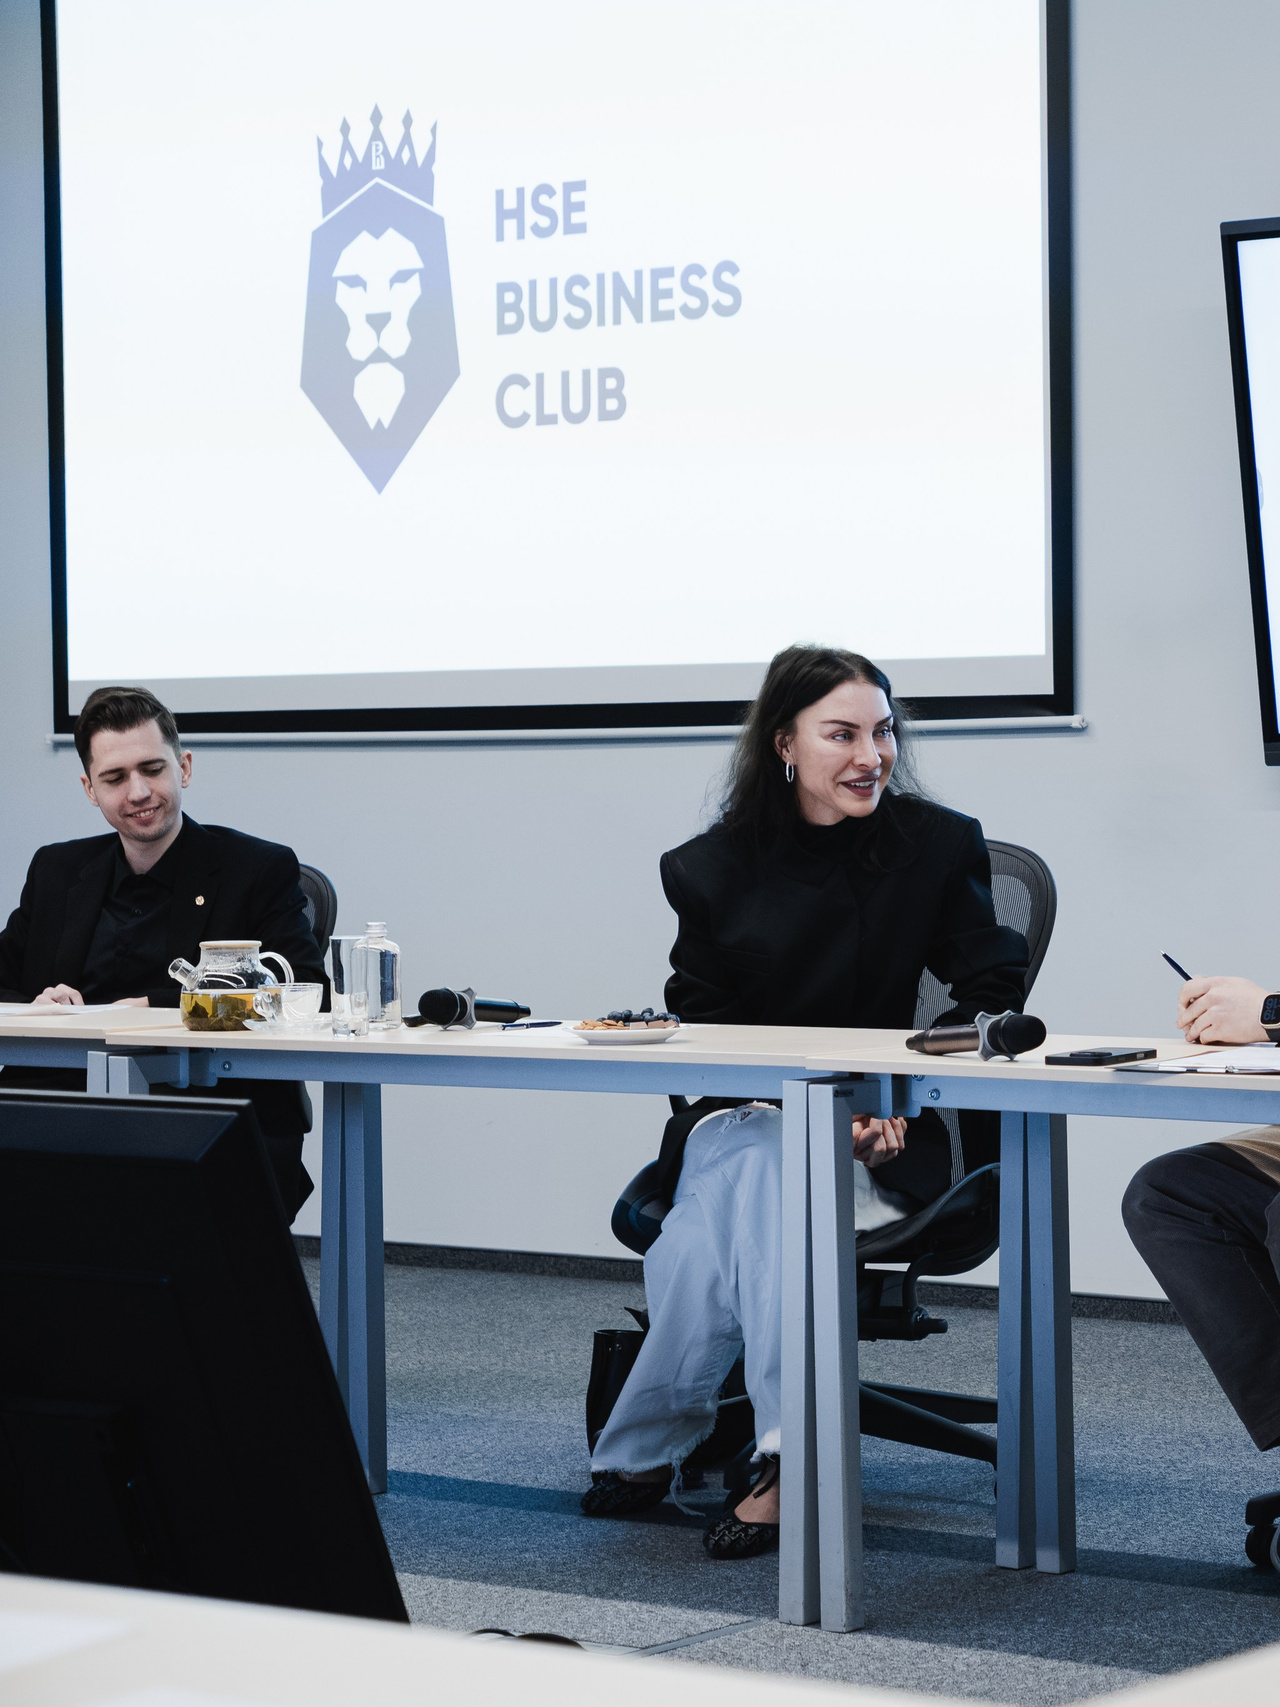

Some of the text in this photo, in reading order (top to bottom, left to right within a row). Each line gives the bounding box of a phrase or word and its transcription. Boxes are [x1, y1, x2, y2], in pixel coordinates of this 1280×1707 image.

[494, 179, 588, 243] HSE
[495, 259, 743, 337] BUSINESS
[494, 366, 628, 430] CLUB
